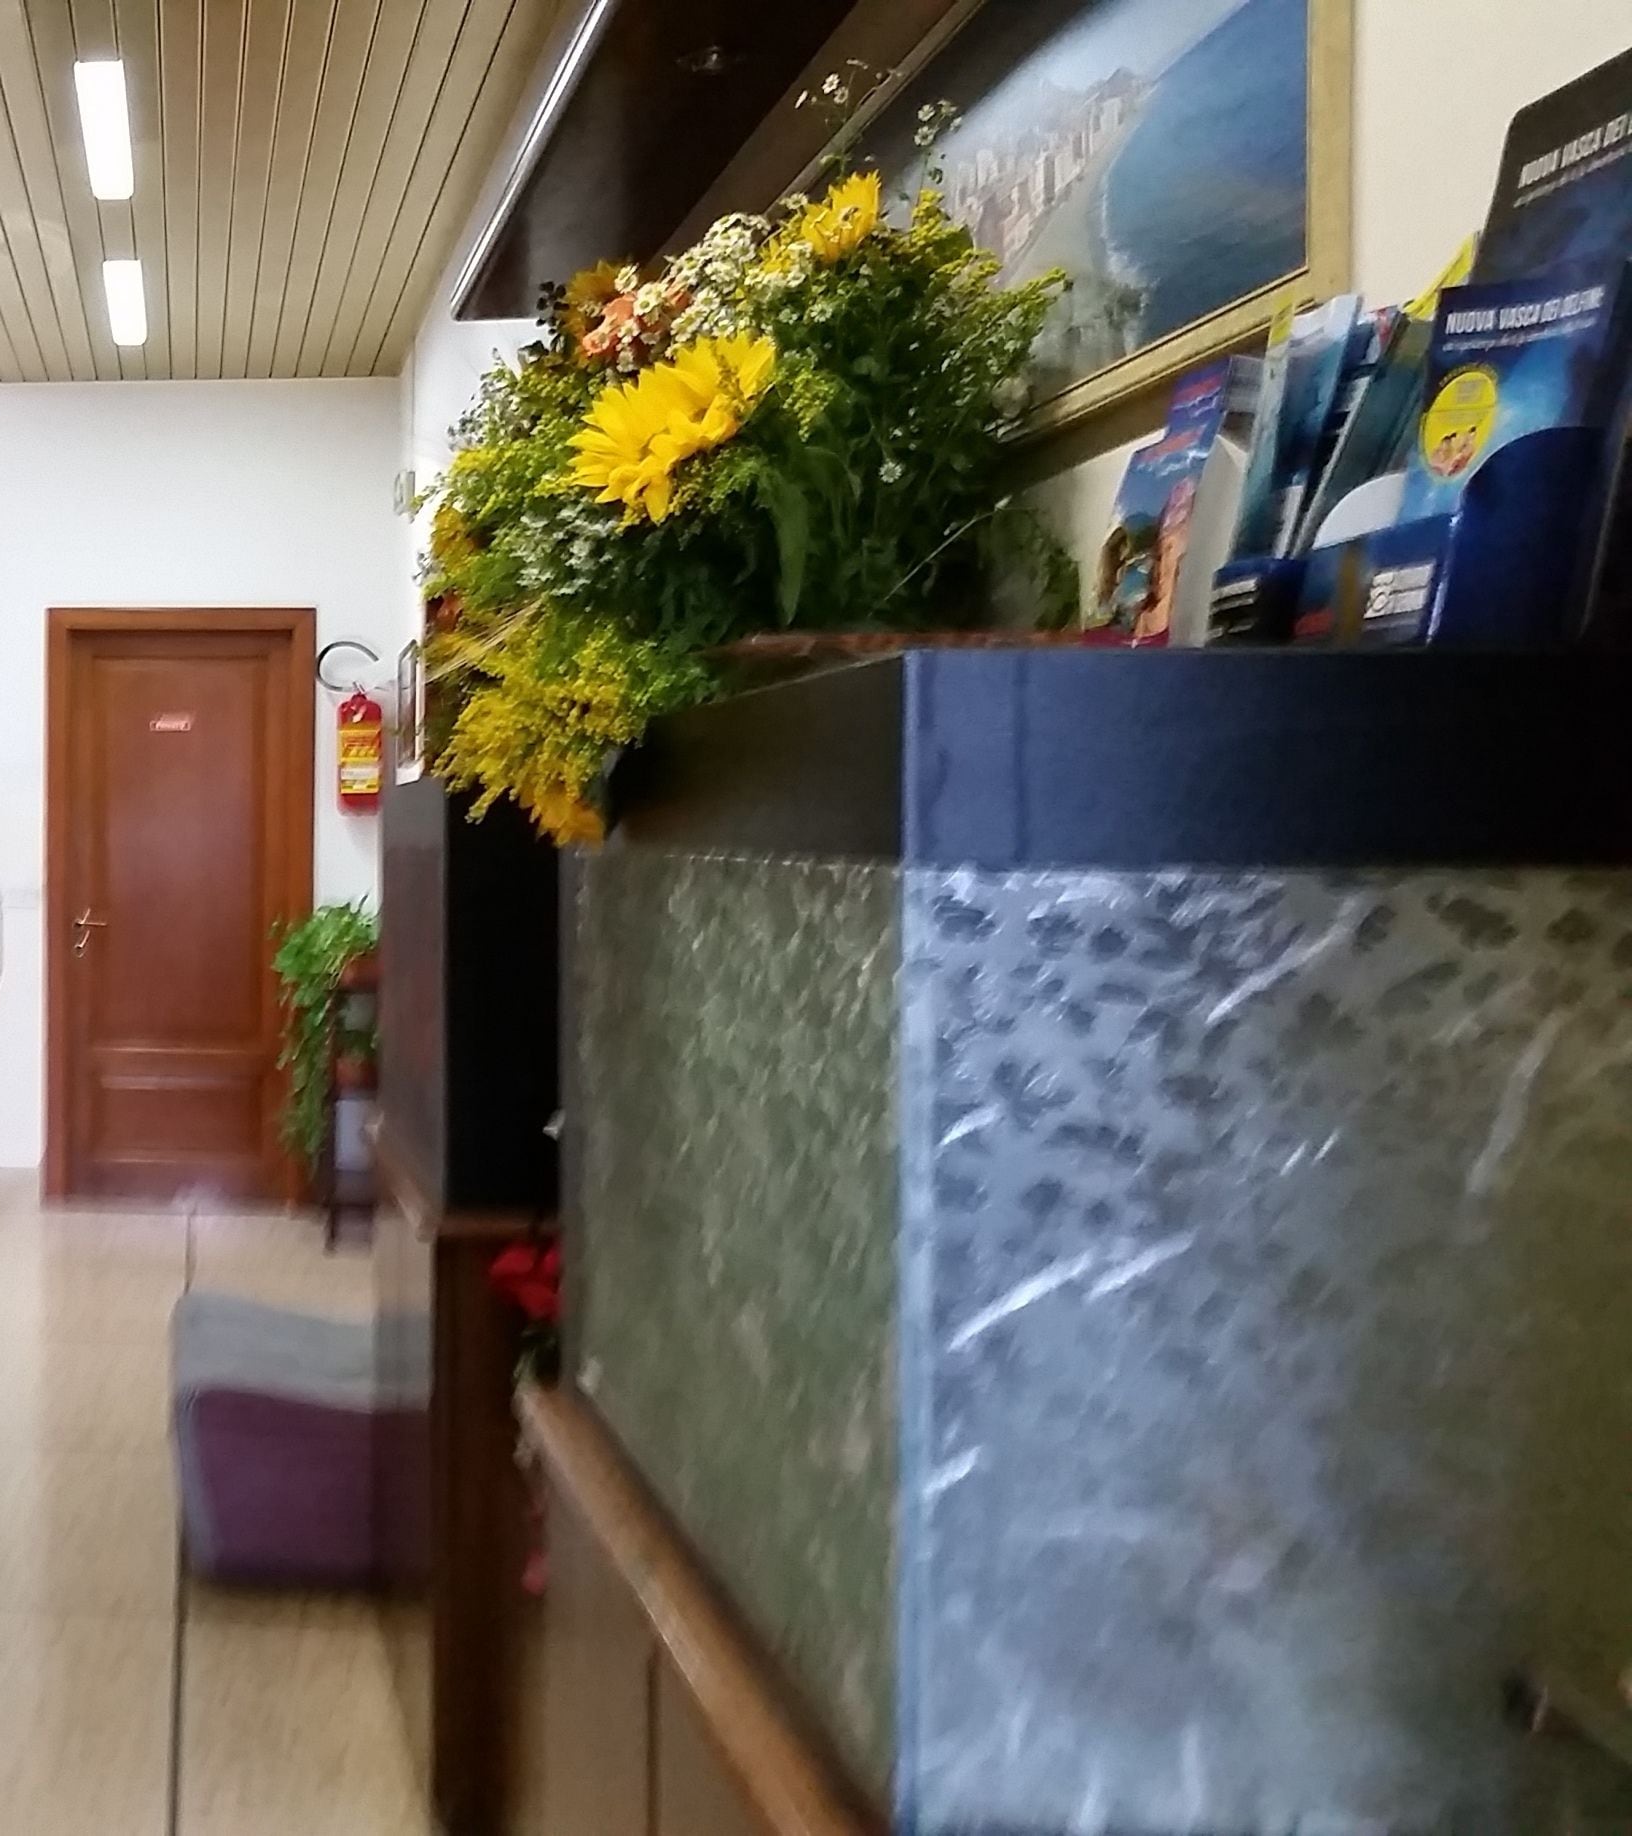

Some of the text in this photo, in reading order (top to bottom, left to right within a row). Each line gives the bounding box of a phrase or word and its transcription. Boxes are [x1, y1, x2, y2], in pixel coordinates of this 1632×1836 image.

[1517, 147, 1562, 189] NUOVA
[1560, 126, 1602, 169] VASCA
[1445, 309, 1496, 335] NUOVA
[1499, 304, 1541, 330] VASCA
